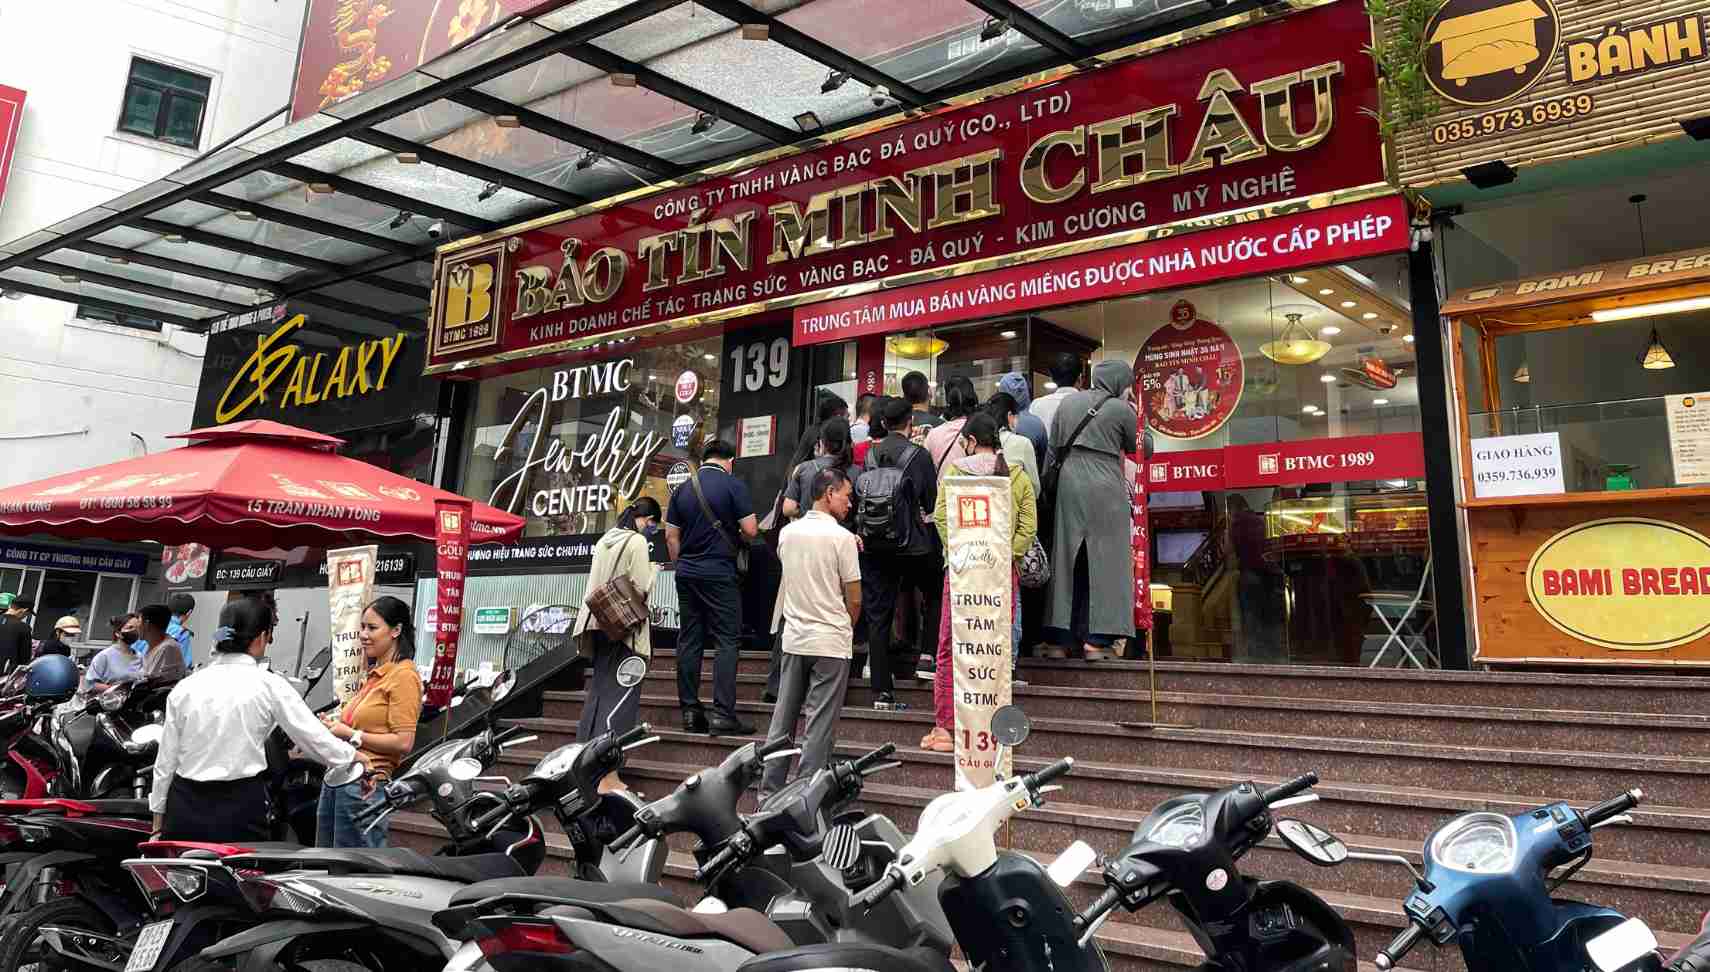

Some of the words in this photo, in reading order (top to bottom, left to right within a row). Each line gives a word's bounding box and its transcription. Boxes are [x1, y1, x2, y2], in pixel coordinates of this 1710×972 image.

[1568, 16, 1702, 82] BÁNH
[1434, 94, 1594, 144] 035.973.6939
[654, 195, 699, 221] CÔNG
[706, 188, 727, 208] TY
[729, 172, 776, 202] TNHH
[779, 159, 829, 190] VÀNG
[833, 147, 873, 174] BẠC
[880, 133, 908, 161] ĐÁ
[914, 119, 955, 151] QUÝ
[960, 112, 1011, 143] (CO.,
[1021, 90, 1073, 122] LTD)
[511, 238, 630, 320] BẢO
[638, 207, 757, 292] TÍN
[767, 149, 1003, 263] MINH
[1020, 61, 1345, 204] CHÂU
[529, 321, 564, 342] KINH
[569, 309, 617, 334] DOANH
[621, 298, 652, 323] CHẾ
[656, 295, 687, 316] TÁC
[693, 281, 747, 307] TRANG
[752, 272, 787, 297] SỨC
[799, 262, 846, 288] VÀNG
[852, 254, 890, 281] BẠC
[910, 244, 937, 267] ĐÁ
[942, 231, 984, 258] QUÝ
[1016, 220, 1055, 245] KIM
[1063, 201, 1147, 236] CƯƠNG
[1172, 184, 1210, 213] MỸ
[1222, 166, 1297, 205] NGHỆ
[801, 311, 851, 335] TRUNG
[854, 301, 886, 326] TÂM
[889, 298, 926, 321] MUA
[929, 288, 965, 313] BÁN
[967, 282, 1017, 307] VÀNG
[1084, 258, 1145, 286] ĐƯỢC
[1149, 247, 1196, 277] NHÀ
[1200, 236, 1268, 268] NƯỚC
[1272, 226, 1322, 255] CẤP
[1326, 215, 1394, 246] PHÉP
[1516, 270, 1605, 296] BAMI
[216, 313, 408, 424] GALAXY
[730, 336, 790, 393] 139
[552, 358, 635, 402] BTMC
[488, 387, 666, 513] Jewelry
[1284, 454, 1336, 471] BTMC
[1339, 451, 1375, 467] 1989
[1476, 448, 1511, 461] GIAO
[1514, 444, 1553, 458] HÀNG
[1173, 464, 1218, 480] BTMC
[1477, 467, 1556, 482] 0359.736.939
[247, 499, 263, 513] 15
[532, 483, 612, 517] CENTER
[511, 547, 537, 559] TRANG
[537, 543, 554, 558] SỨC
[556, 542, 589, 557] CHUYÊN
[230, 568, 240, 580] 139
[1542, 568, 1613, 596] BAMI
[954, 593, 1002, 608] TRUNG
[965, 615, 996, 632] TÂM
[957, 641, 1003, 657] TRANG
[968, 664, 997, 681] SỨC
